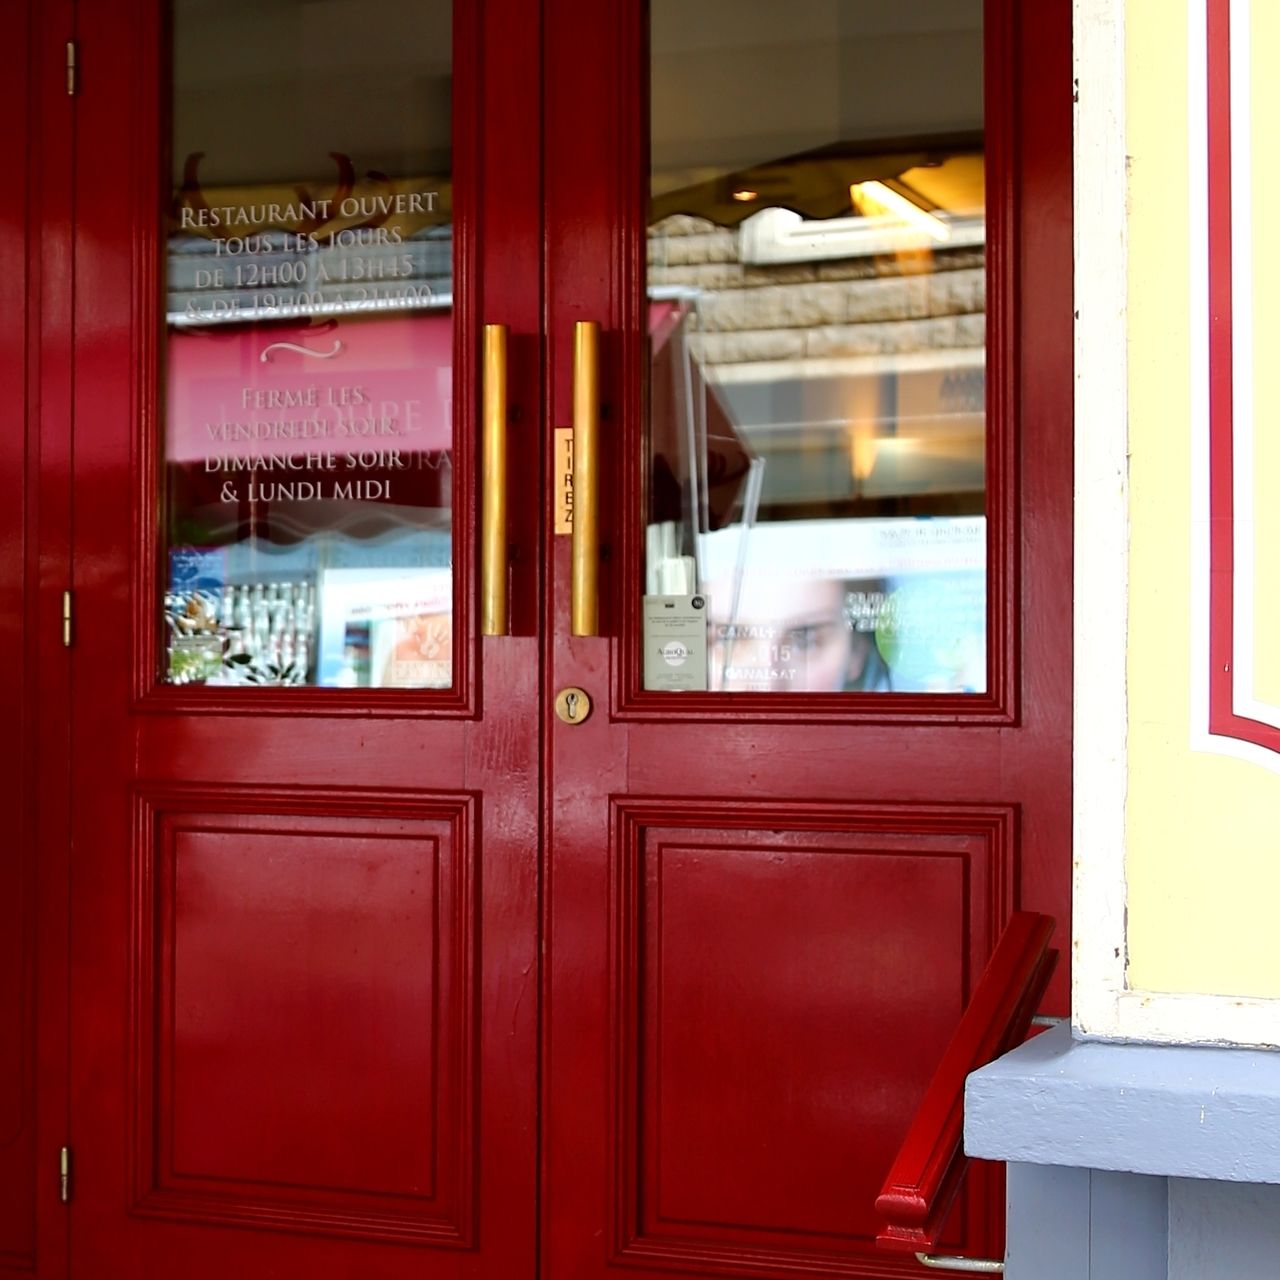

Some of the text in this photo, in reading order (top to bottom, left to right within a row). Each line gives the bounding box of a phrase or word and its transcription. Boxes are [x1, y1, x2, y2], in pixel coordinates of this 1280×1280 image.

[339, 192, 438, 218] OUVERT
[213, 225, 403, 257] TOUS LES JOURS
[194, 269, 224, 288] DE
[235, 260, 308, 287] 12H00
[212, 296, 242, 320] DE
[328, 384, 365, 407] LES
[206, 418, 332, 442] VENDREDI
[205, 449, 337, 473] DIMANCHE
[347, 447, 404, 470] SOIR
[220, 478, 391, 503] & LUNDI MIDI
[564, 438, 574, 523] TIREZ
